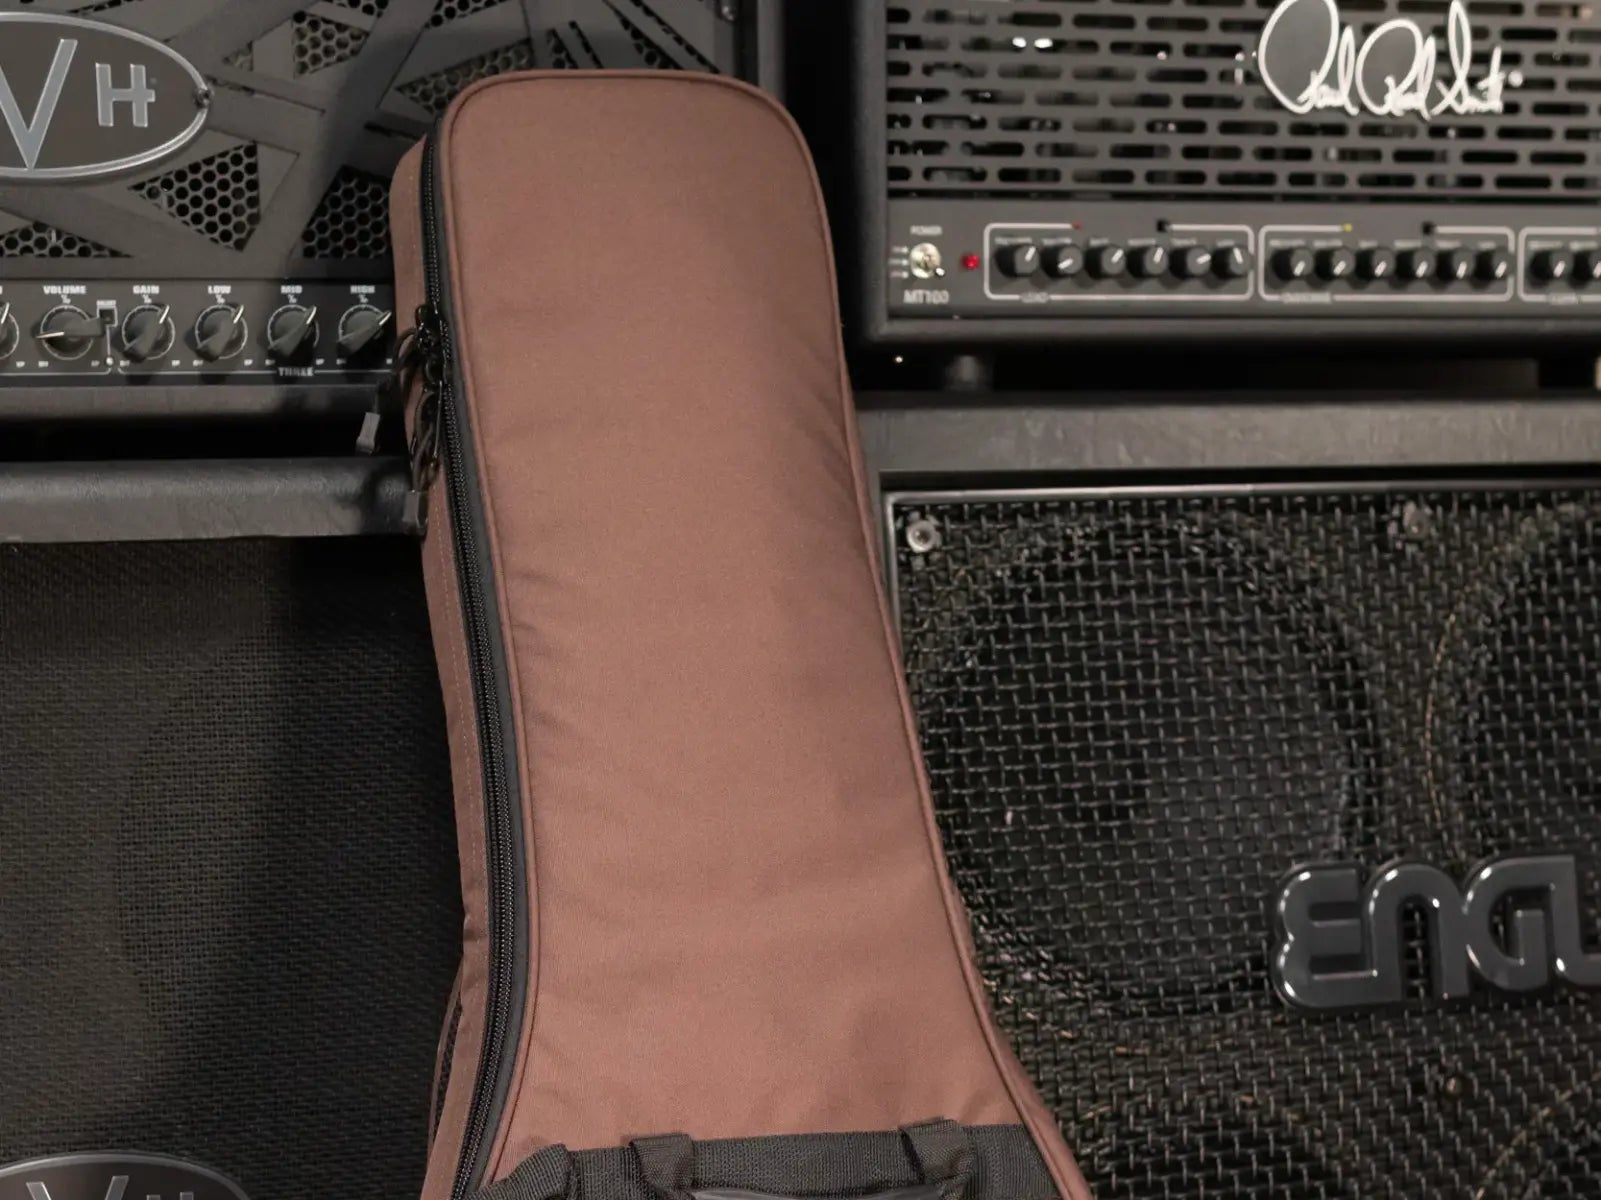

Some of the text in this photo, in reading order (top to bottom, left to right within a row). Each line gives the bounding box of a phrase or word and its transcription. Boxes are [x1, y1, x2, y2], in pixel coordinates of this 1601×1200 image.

[43, 285, 375, 294] VOLUME GAIN LOW MID HIGH
